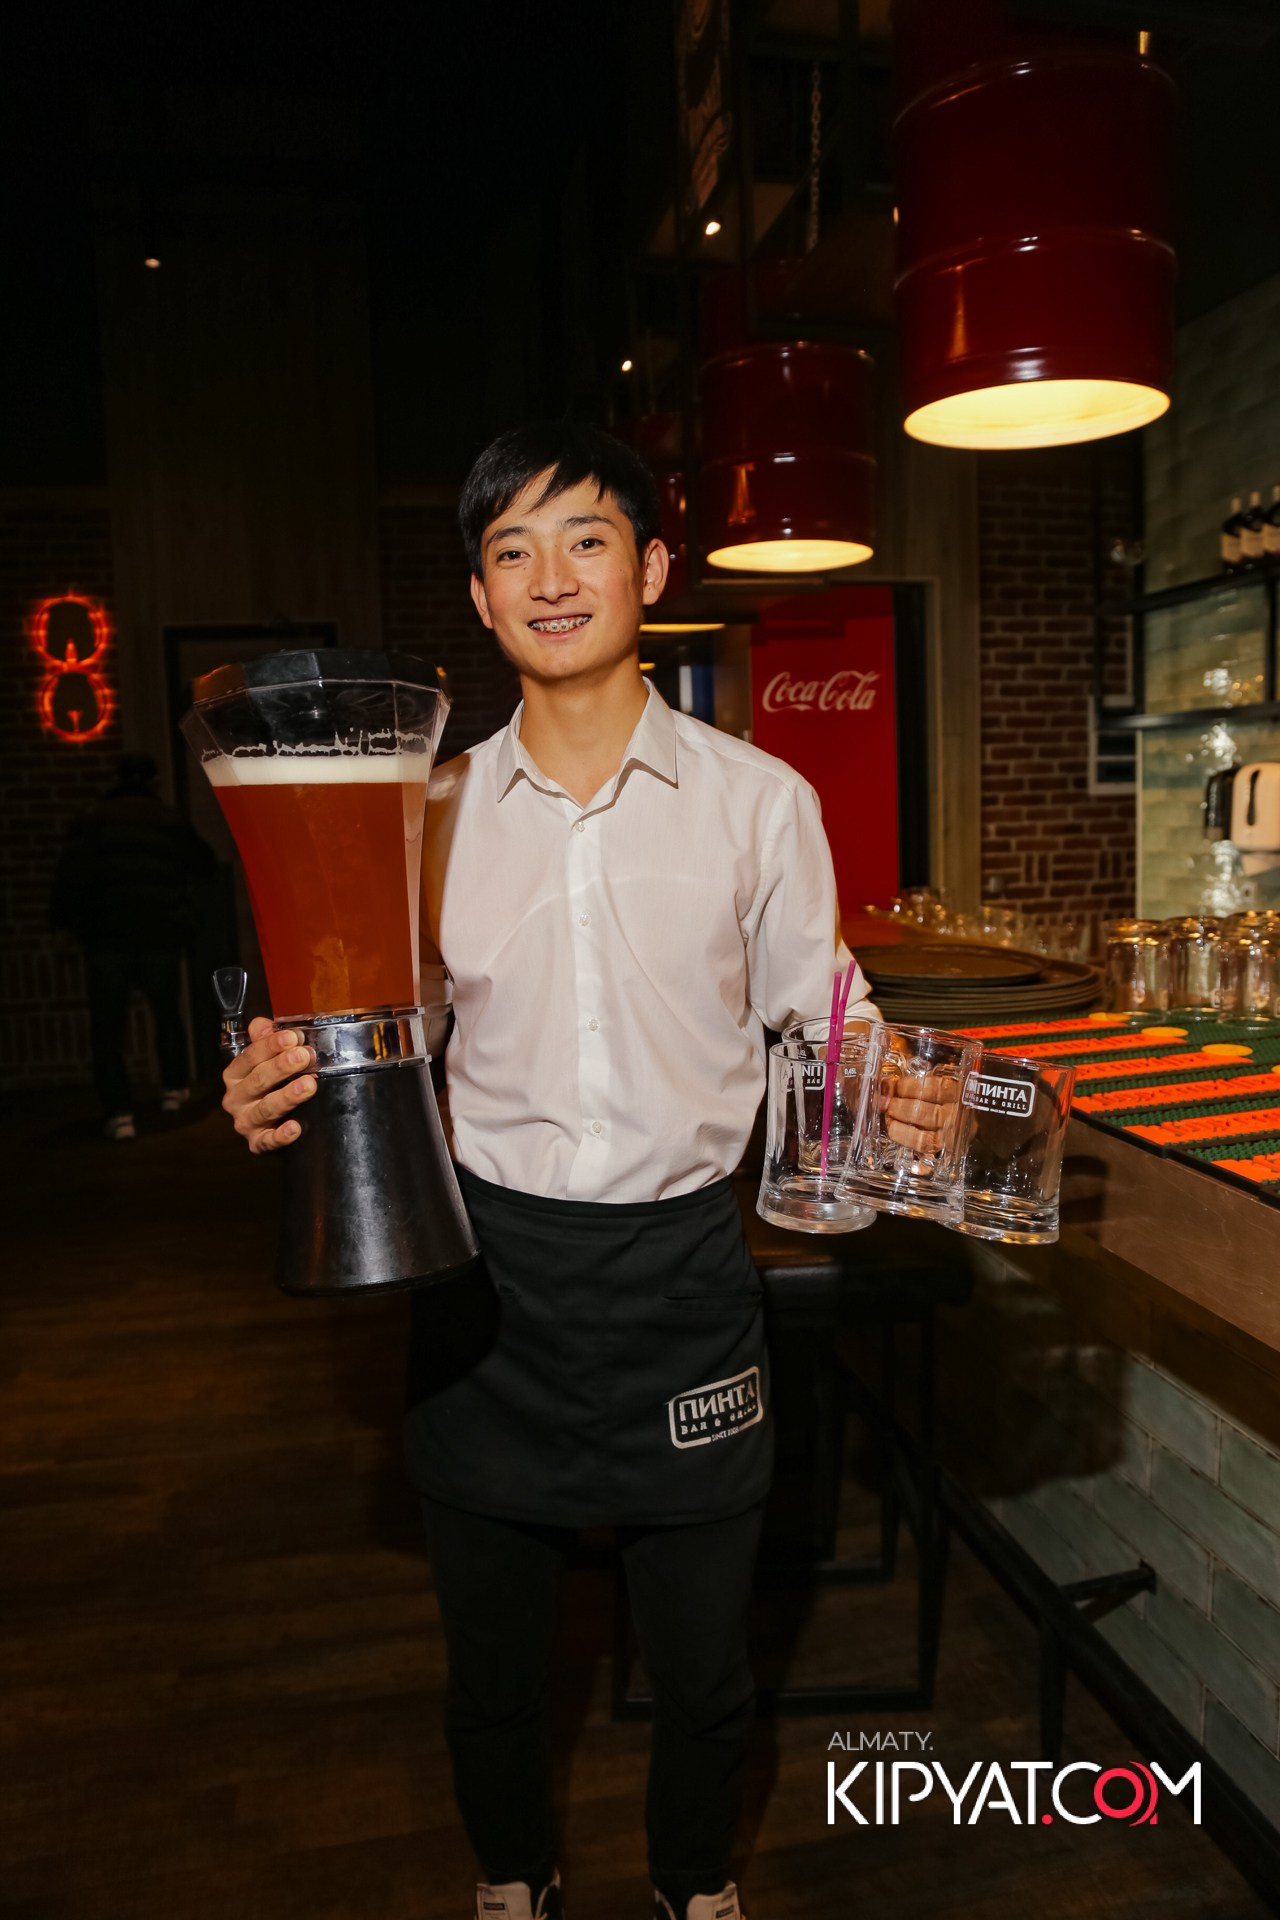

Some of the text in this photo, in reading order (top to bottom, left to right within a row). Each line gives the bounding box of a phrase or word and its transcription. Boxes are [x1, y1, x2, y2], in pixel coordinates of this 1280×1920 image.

[762, 670, 880, 713] Coca-Cola
[977, 1082, 1027, 1103] ПИНТА
[1001, 1102, 1026, 1110] GRILL
[679, 1380, 756, 1422] ПИНТА
[681, 1422, 708, 1434] BAR
